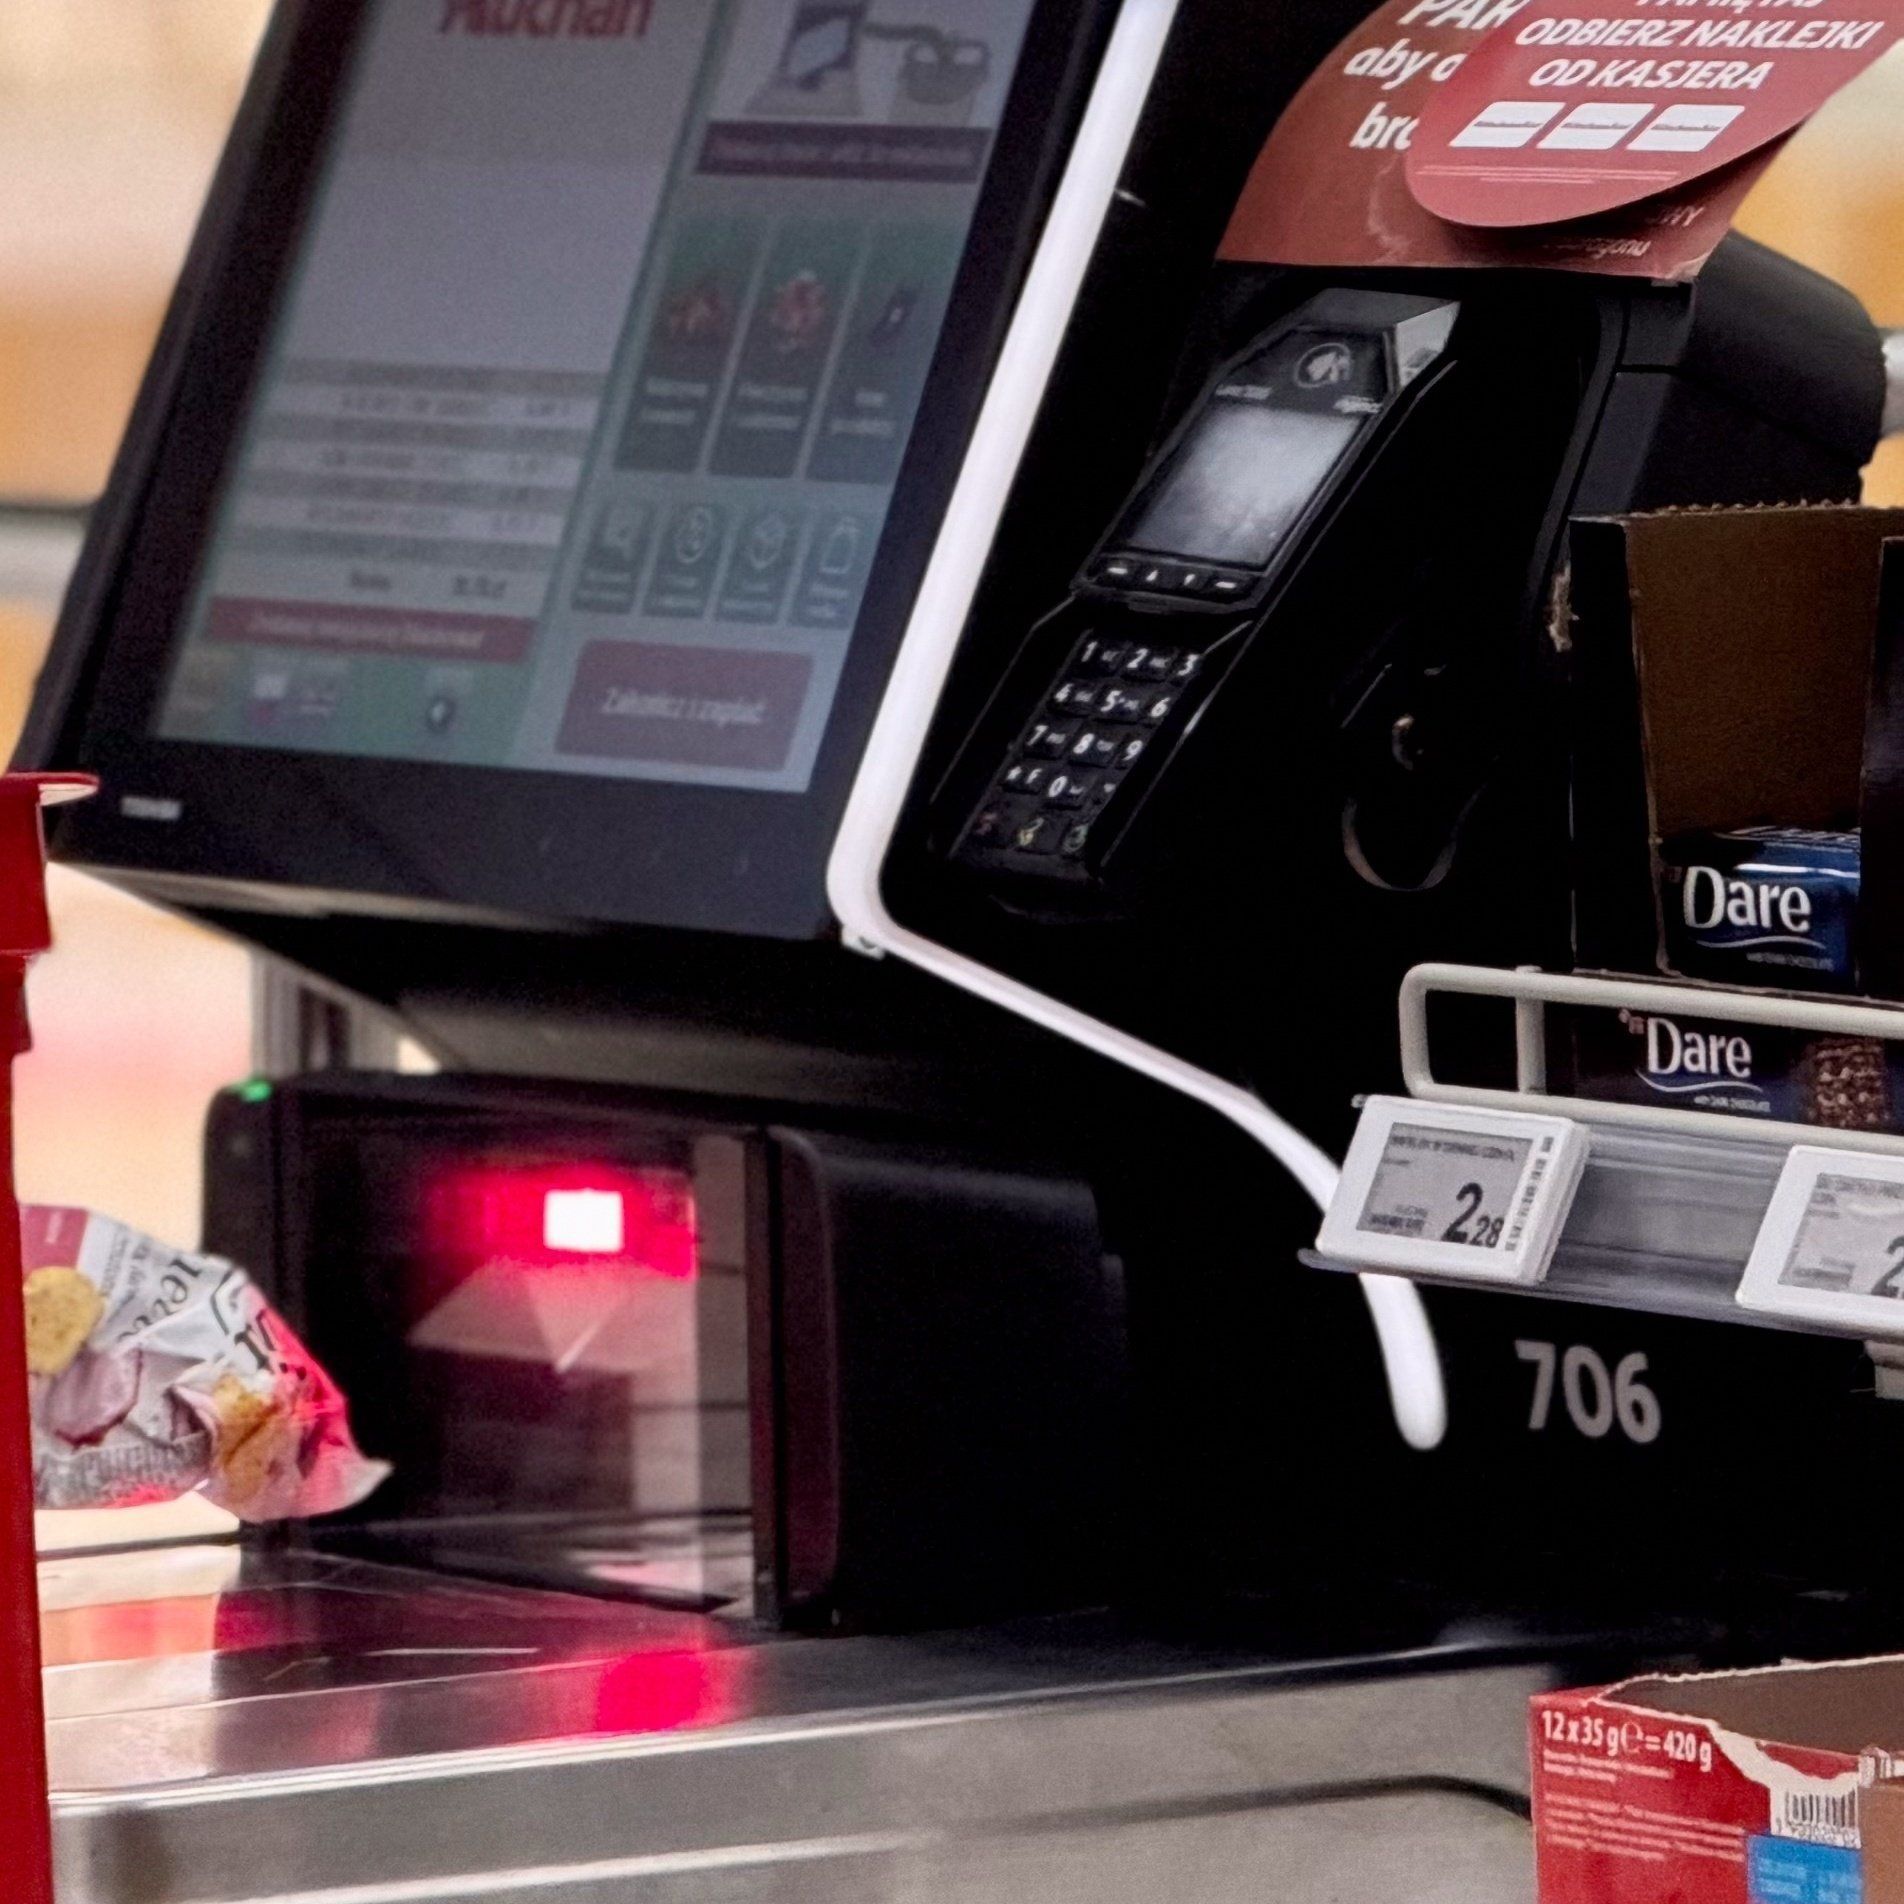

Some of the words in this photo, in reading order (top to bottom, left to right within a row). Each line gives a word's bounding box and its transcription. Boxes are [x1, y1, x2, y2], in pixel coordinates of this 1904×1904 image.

[1515, 16, 1696, 47] ODBIERZ
[1679, 19, 1885, 50] NAKLEJKI
[1343, 38, 1440, 91] aby
[1527, 58, 1598, 88] OD
[1587, 60, 1776, 90] KASJERA
[1682, 865, 1813, 934] Dare
[1647, 1017, 1753, 1080] Dare
[1514, 1338, 1662, 1444] 706
